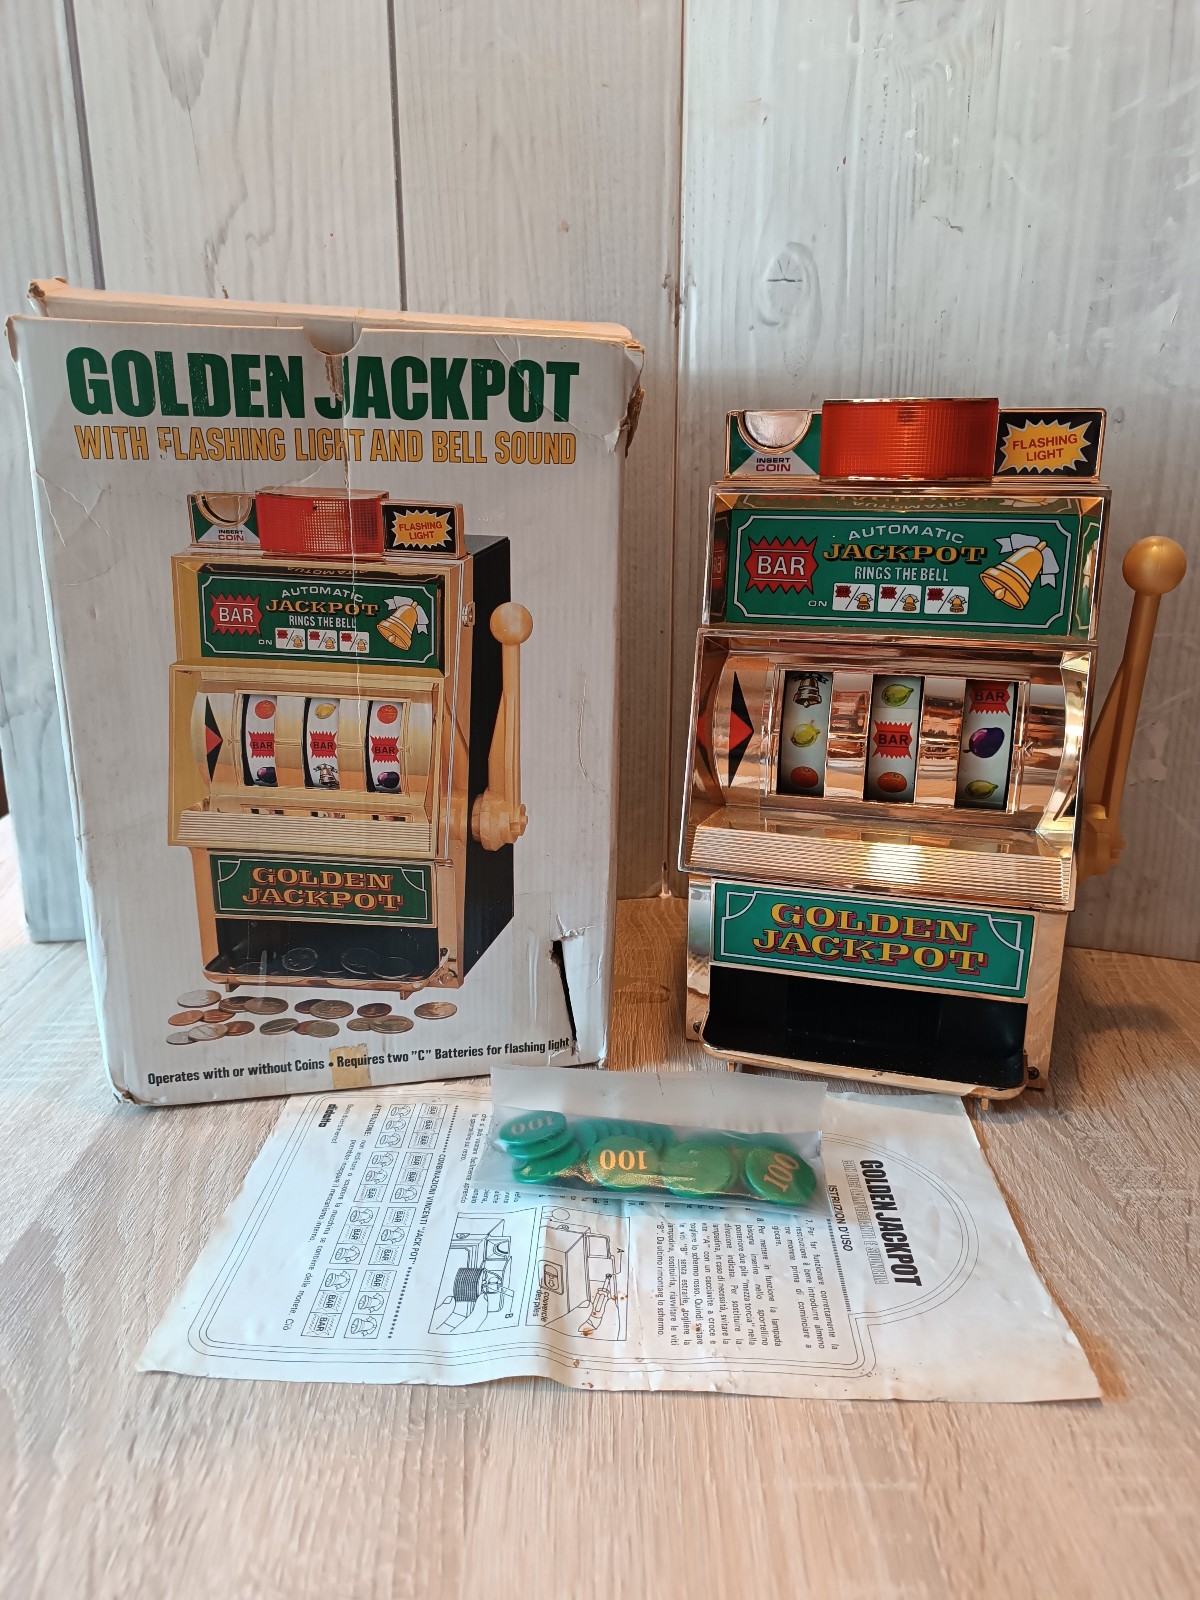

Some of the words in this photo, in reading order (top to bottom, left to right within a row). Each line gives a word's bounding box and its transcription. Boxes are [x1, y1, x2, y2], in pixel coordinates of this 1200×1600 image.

[66, 347, 305, 418] GOLDEN
[314, 355, 580, 423] JACKPOT
[74, 425, 149, 460] WITH
[157, 426, 286, 461] FLASHING
[294, 427, 365, 462] LIGHT
[370, 429, 423, 462] AND
[432, 430, 487, 463] BELL
[495, 431, 576, 464] SOUND
[1012, 433, 1078, 451] FLASHING
[1026, 448, 1064, 462] LIGHT
[755, 463, 791, 472] COIN
[399, 521, 442, 532] FLASHING
[409, 531, 435, 540] LIGHT
[849, 524, 965, 543] AUTOMATIC
[218, 534, 244, 542] COIN
[823, 543, 988, 565] JACKPOT
[757, 555, 805, 576] BAR
[854, 566, 892, 580] RINGS
[895, 567, 918, 581] THE
[920, 568, 949, 582] BELL
[281, 586, 364, 603] AUTOMATIC
[219, 606, 254, 623] BAR
[265, 599, 380, 617] JACKPOT
[289, 615, 315, 627] RINGS
[316, 616, 334, 628] THE
[336, 617, 356, 629] BELL
[974, 691, 1005, 702] BAR
[252, 741, 273, 750] BAR
[313, 741, 334, 750] BAR
[878, 734, 909, 745] BAR
[374, 746, 395, 755] BAR
[252, 866, 394, 890] GOLDEN
[242, 887, 404, 911] JACKPOT
[771, 903, 978, 947] GOLDEN
[752, 929, 988, 976] JACKPOT
[148, 1071, 200, 1087] Operates
[203, 1067, 230, 1080] with
[233, 1068, 245, 1077] or
[248, 1061, 293, 1076] without
[295, 1059, 325, 1071] Coins
[337, 1053, 385, 1068] Requires
[387, 1052, 409, 1063] two
[435, 1045, 484, 1060] Batteries
[487, 1044, 501, 1055] for
[505, 1041, 546, 1055] flashing
[548, 1037, 570, 1051] light
[599, 1149, 648, 1171] 100
[764, 1153, 800, 1193] 100
[860, 1160, 898, 1211] GOLDEN
[419, 1196, 435, 1225] VINCENTI
[838, 1226, 853, 1252] D'USO
[875, 1212, 922, 1287] JACKPOT
